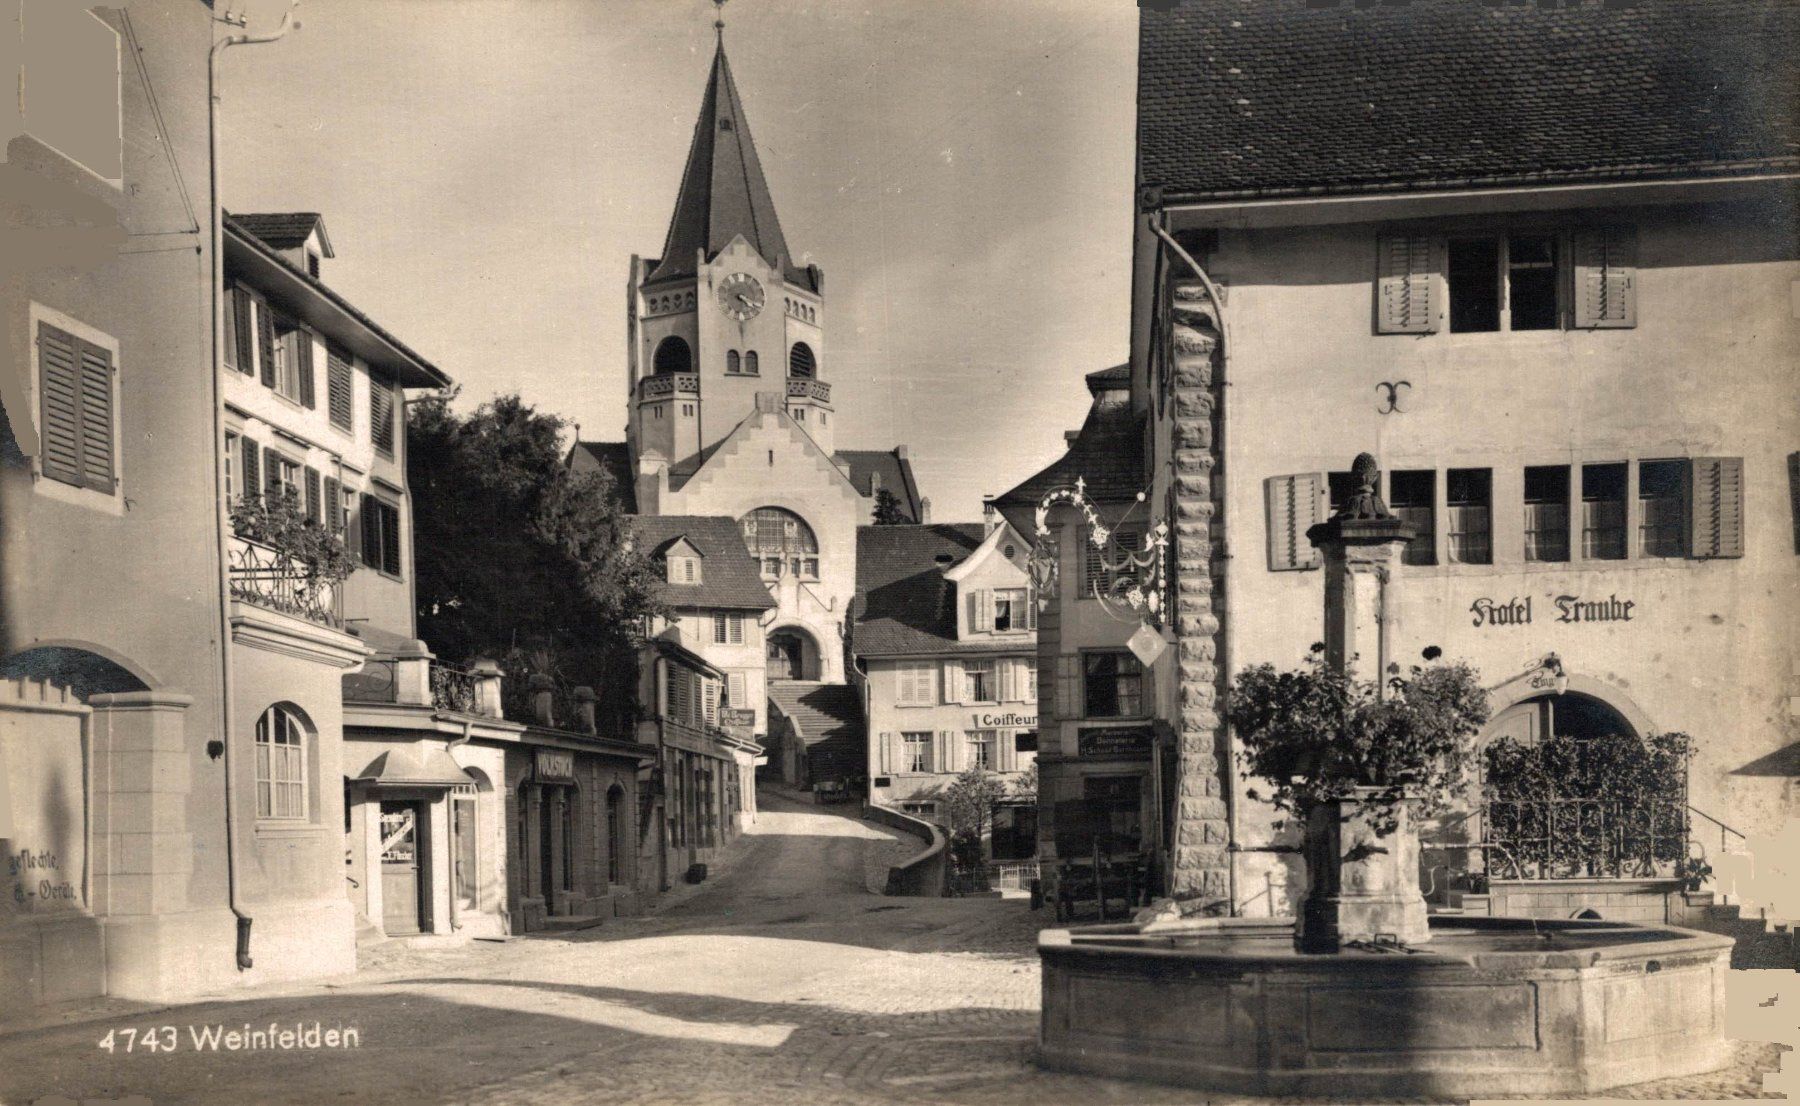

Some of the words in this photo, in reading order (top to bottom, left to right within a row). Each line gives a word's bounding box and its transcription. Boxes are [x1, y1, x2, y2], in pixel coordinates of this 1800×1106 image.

[1470, 596, 1532, 628] Hotel
[1554, 594, 1635, 624] Traube
[983, 713, 1038, 726] Coiffeur
